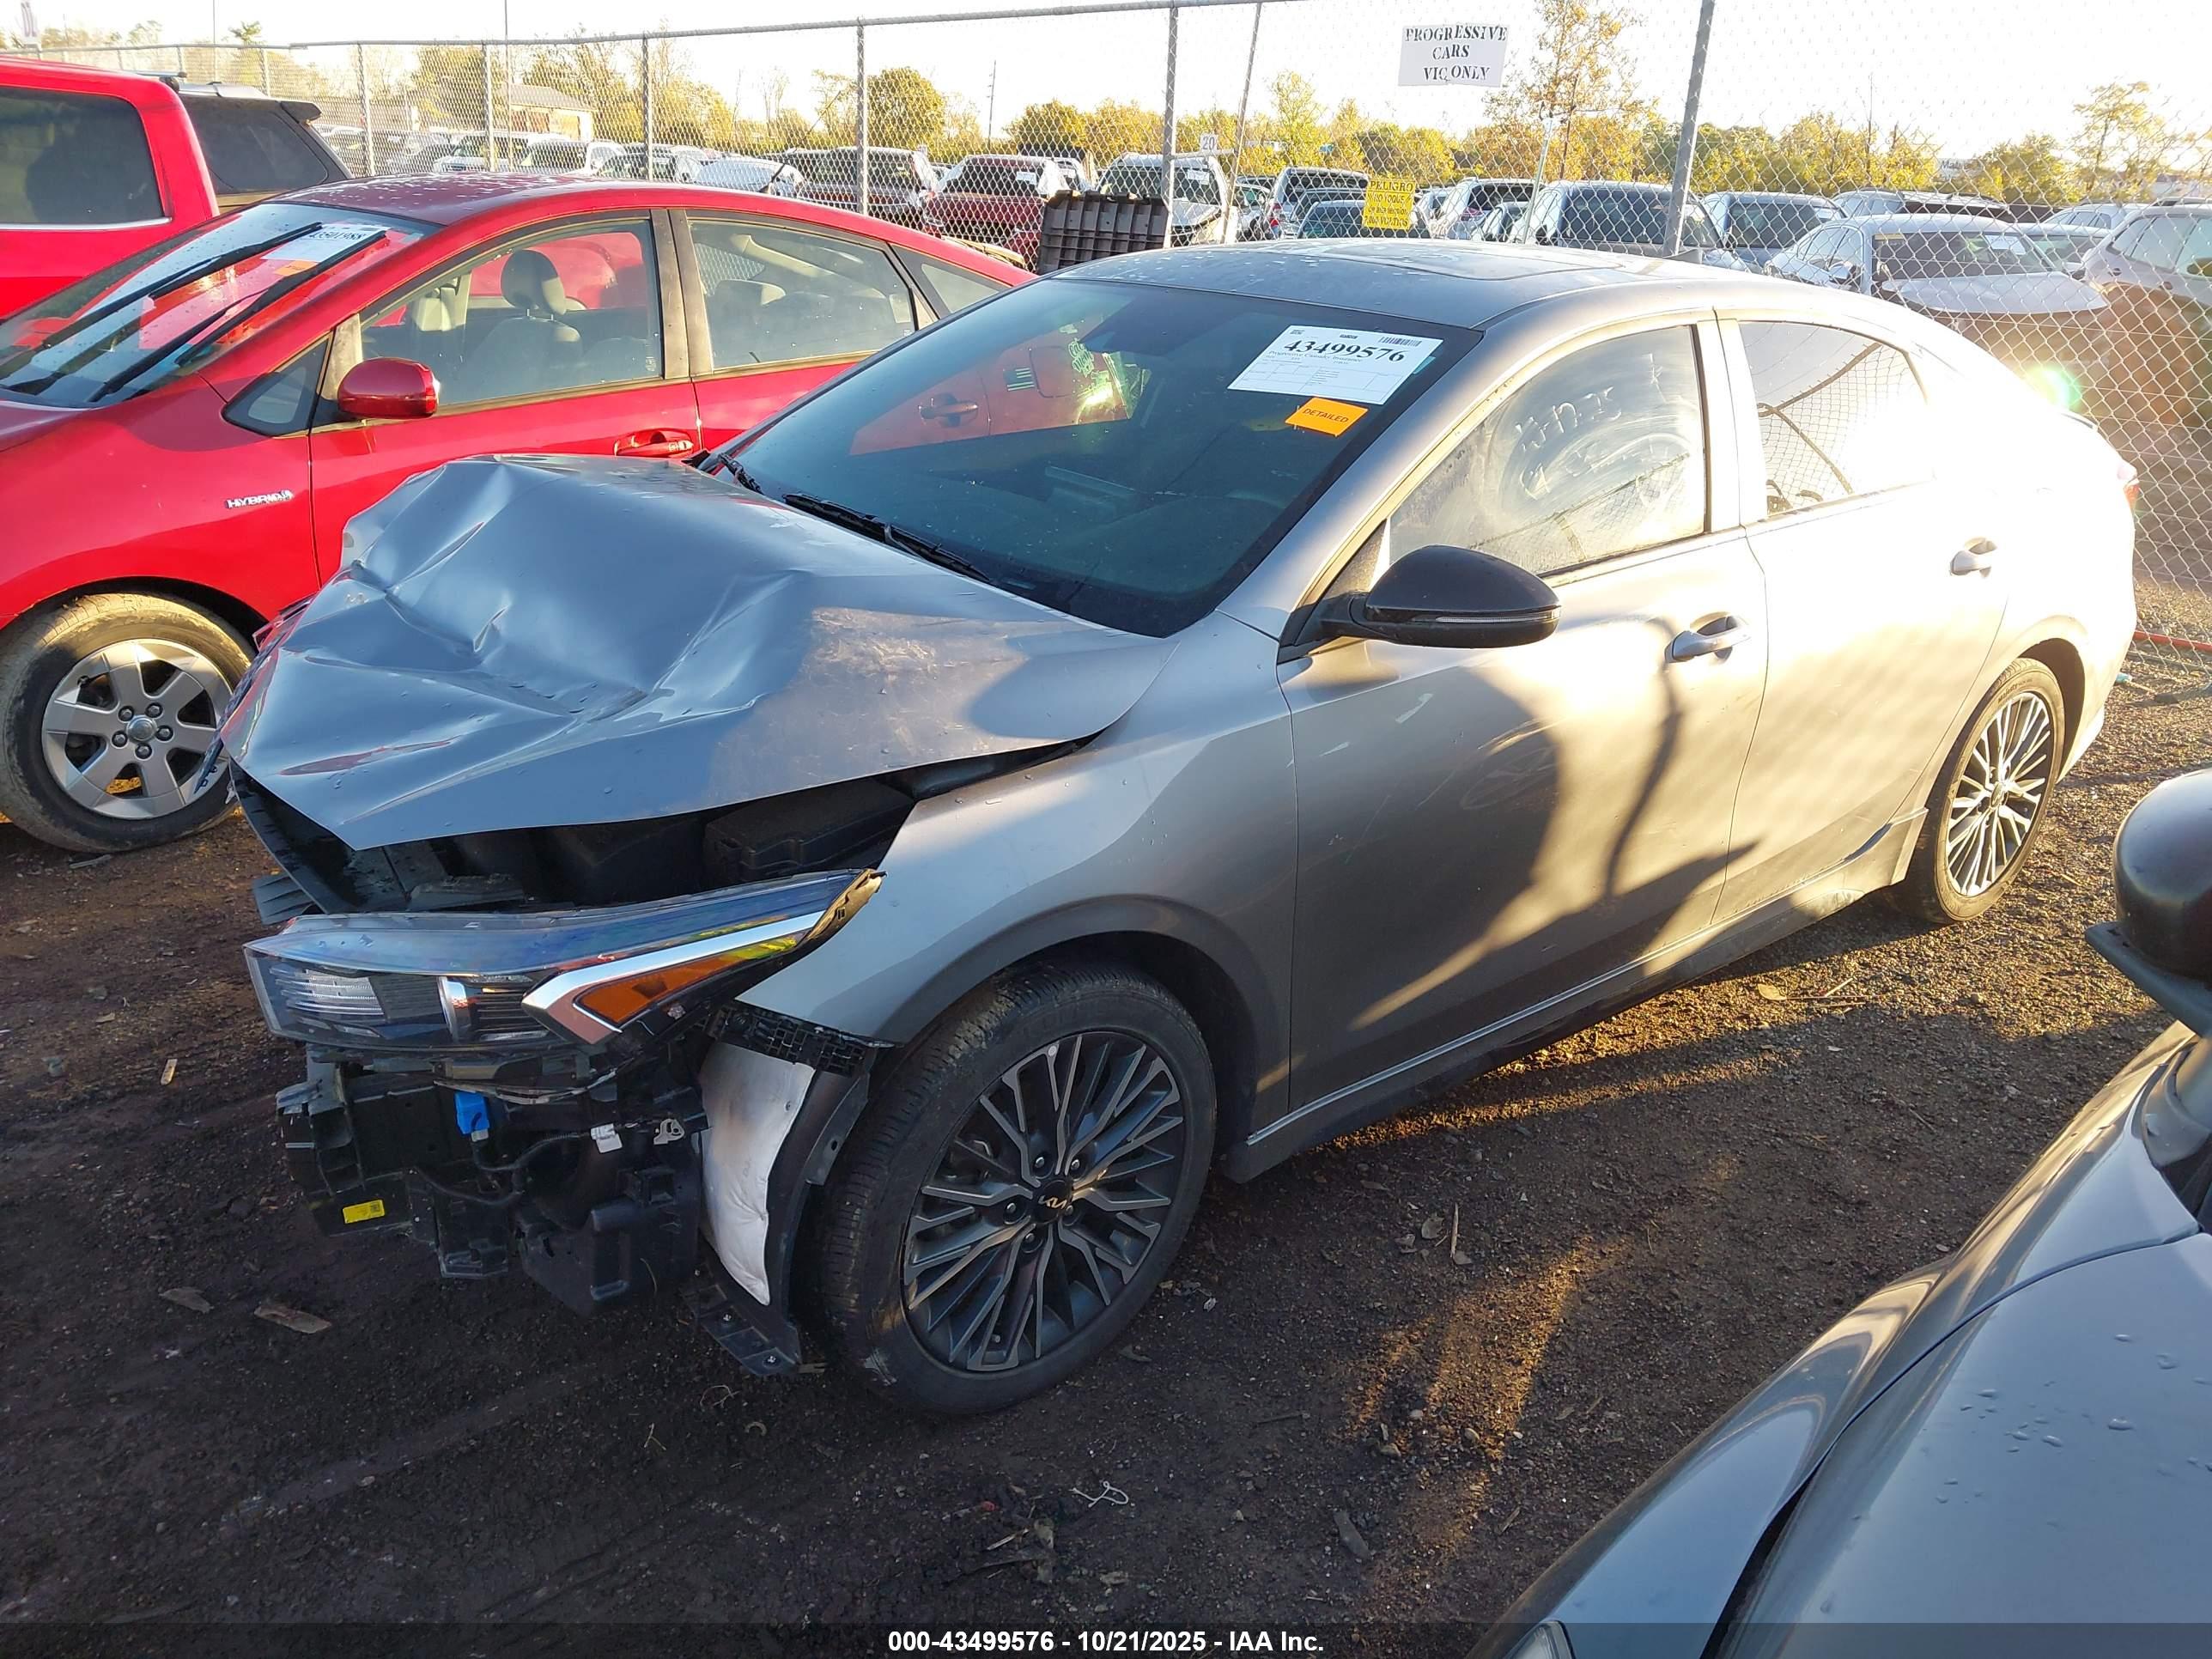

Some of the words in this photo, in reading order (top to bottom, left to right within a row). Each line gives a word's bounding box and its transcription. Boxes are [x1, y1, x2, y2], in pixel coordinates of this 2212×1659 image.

[1405, 25, 1507, 41] PROGRESSIVE
[1432, 44, 1470, 60] CARS
[1451, 65, 1490, 80] ONLY
[1370, 180, 1413, 191] PELIGRO
[1284, 339, 1408, 362] 43499576
[1304, 408, 1350, 423] DETAILED
